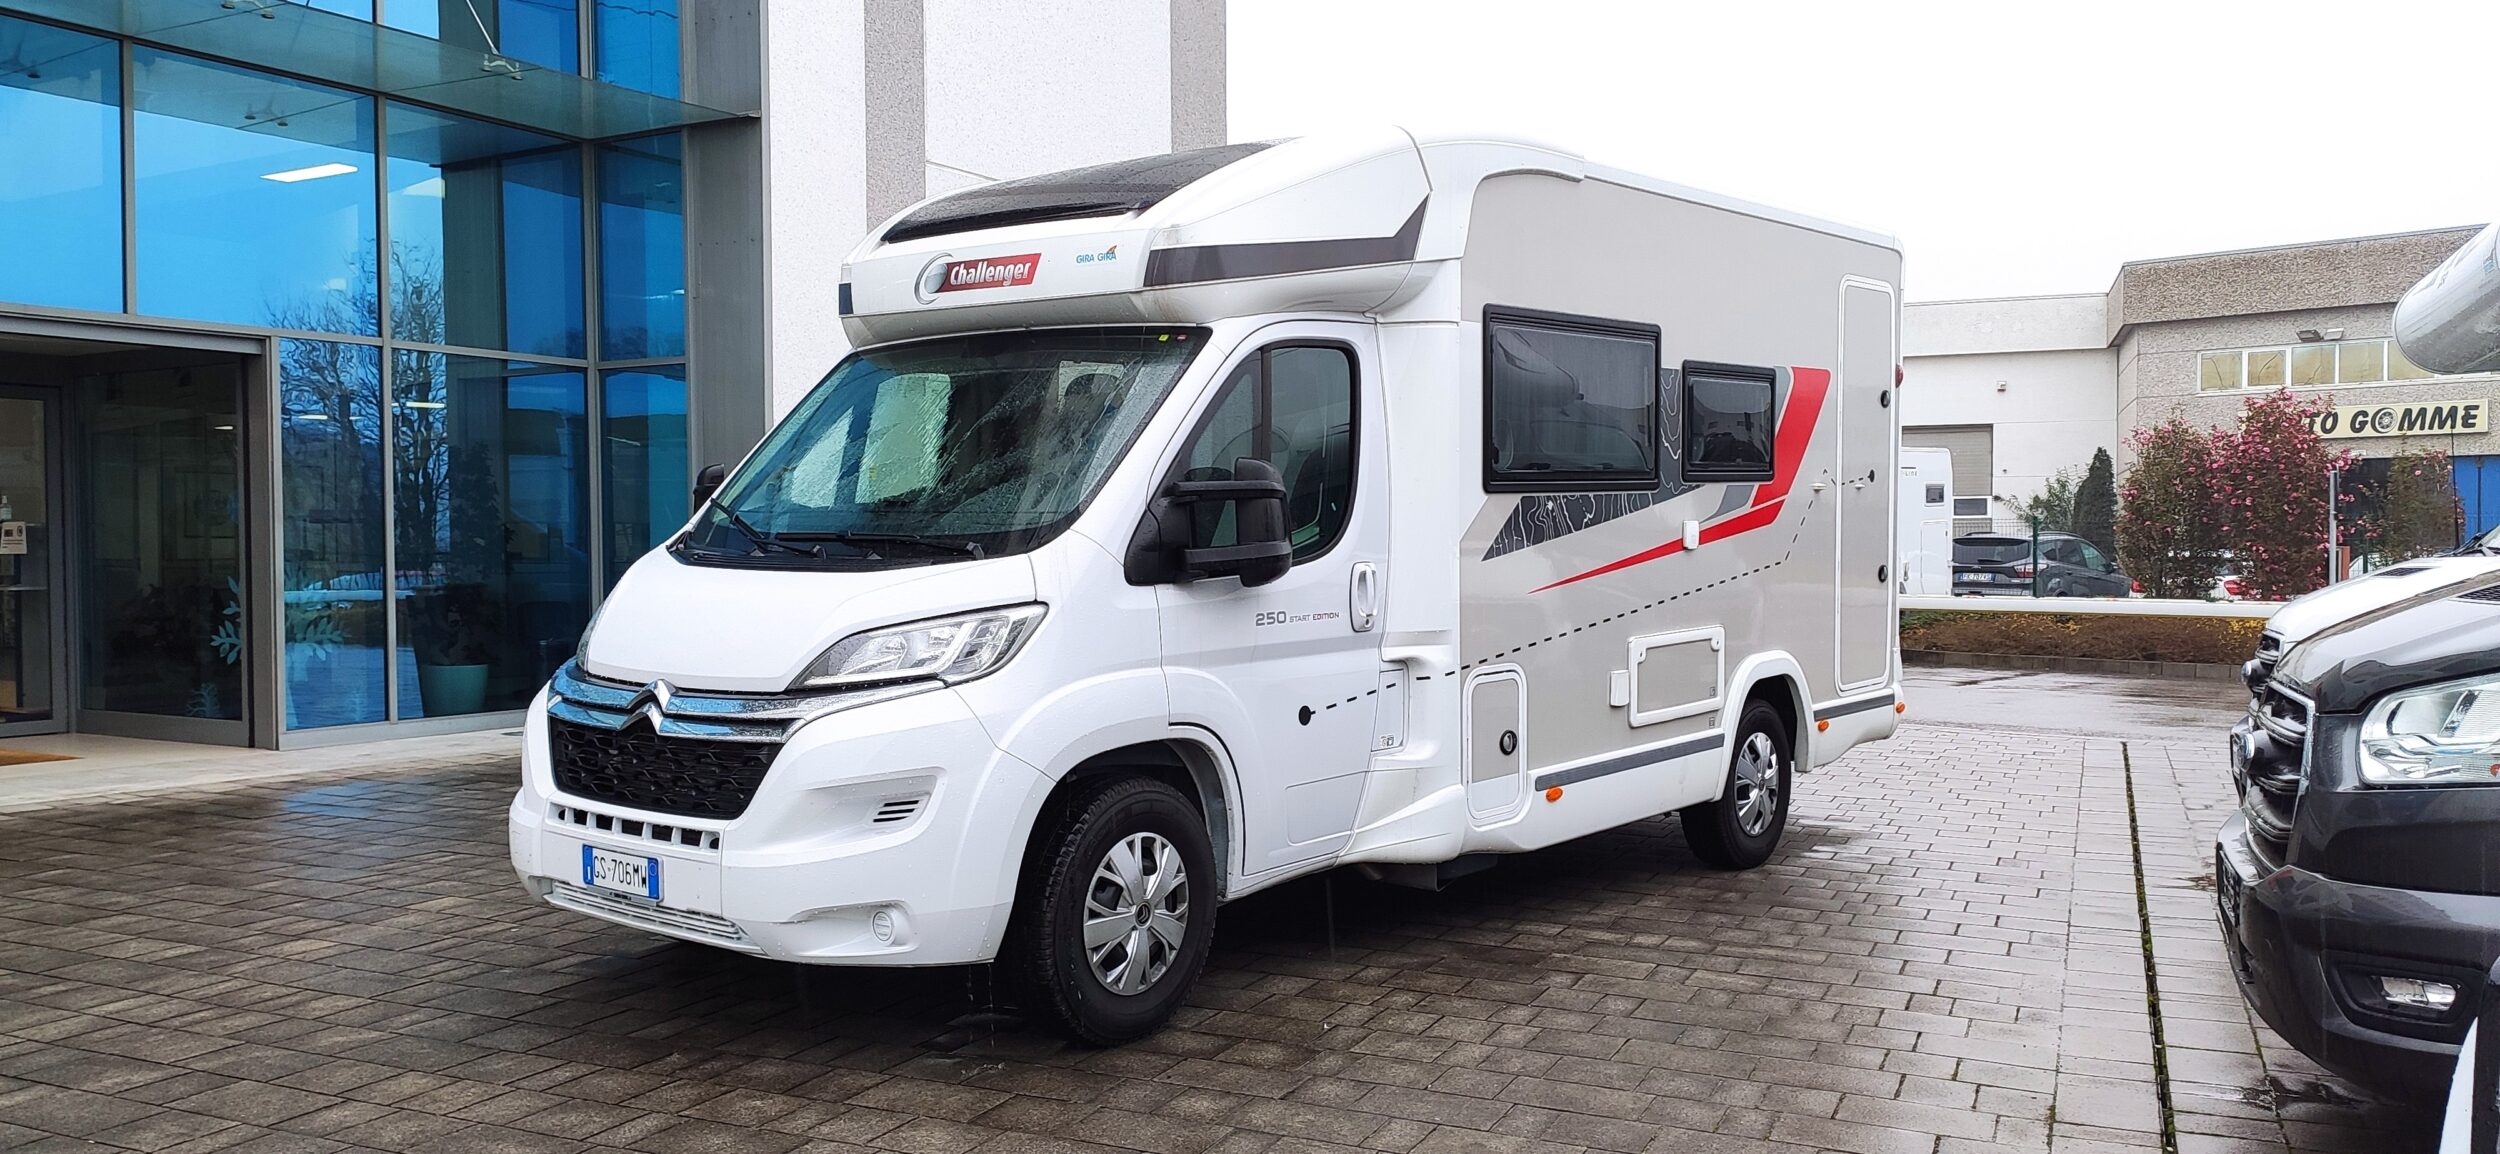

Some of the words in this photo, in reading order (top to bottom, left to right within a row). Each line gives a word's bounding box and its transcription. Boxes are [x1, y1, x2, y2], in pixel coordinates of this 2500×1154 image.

[1076, 253, 1095, 265] GIRA
[1097, 252, 1117, 262] GIRA
[950, 261, 1031, 286] Challenger
[2350, 404, 2481, 434] GOMME
[1255, 611, 1287, 627] 250
[1289, 615, 1311, 623] START
[1312, 612, 1340, 621] EDITION
